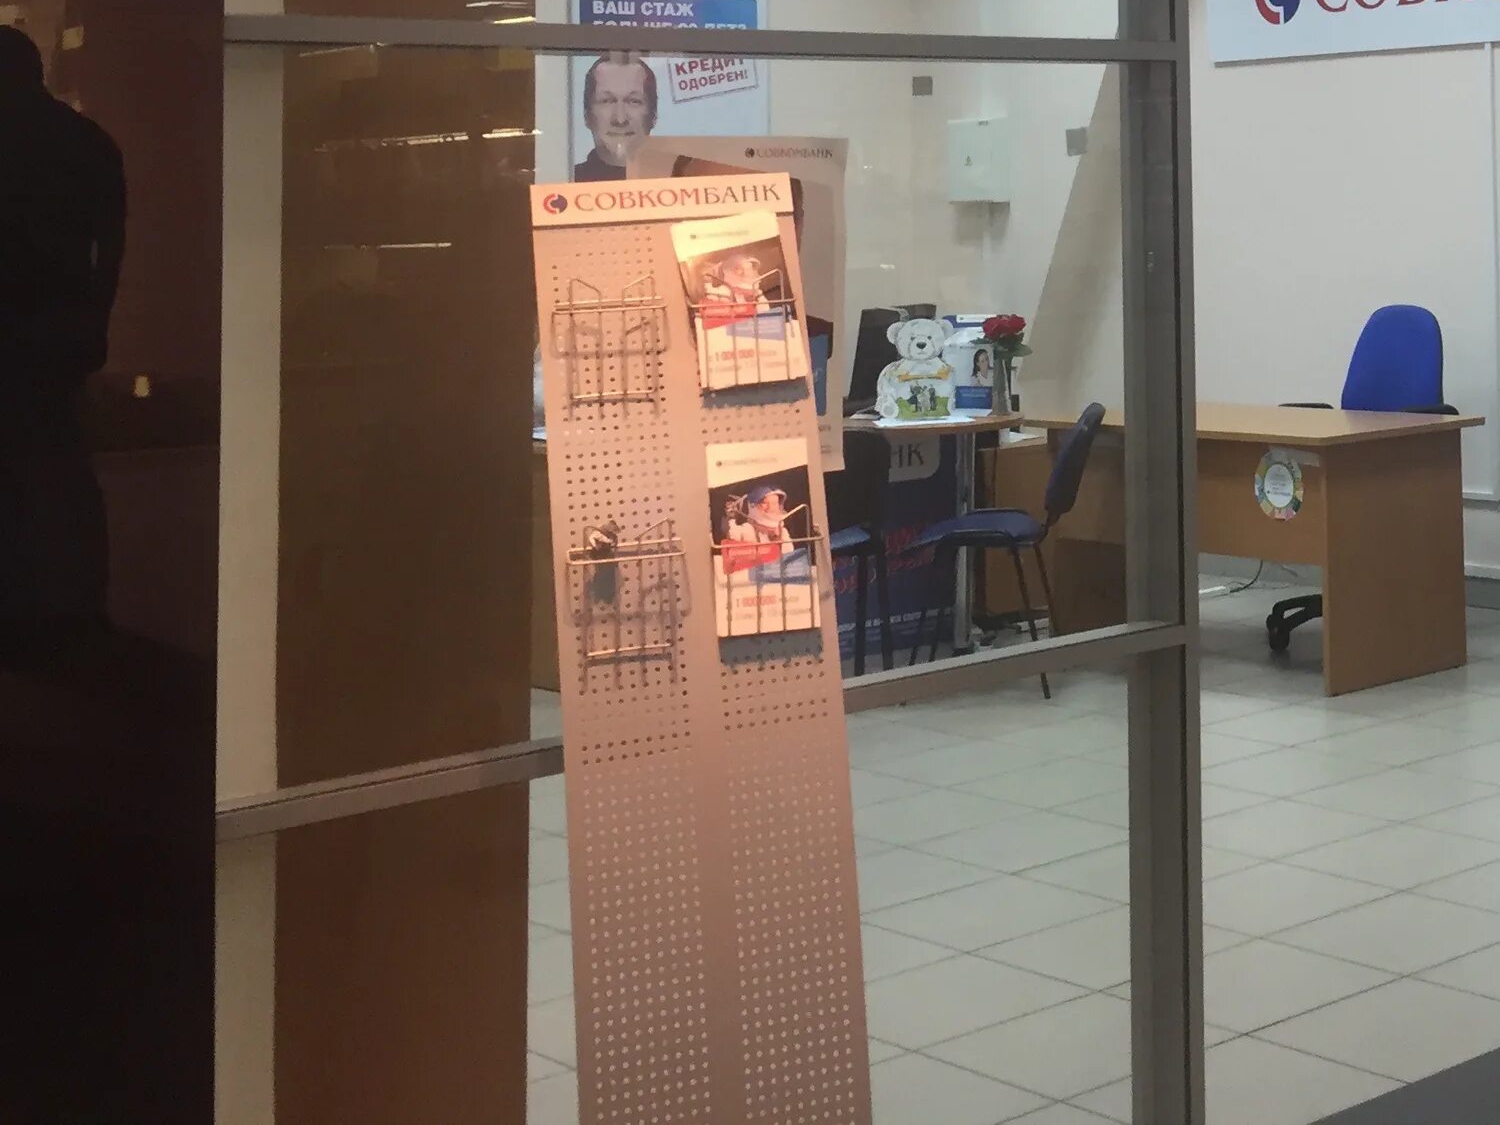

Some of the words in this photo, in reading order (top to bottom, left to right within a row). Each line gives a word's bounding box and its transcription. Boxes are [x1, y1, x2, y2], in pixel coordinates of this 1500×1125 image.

[592, 0, 636, 16] ВАШ
[640, 1, 694, 17] СТАЖ
[678, 69, 748, 91] ОДОБРЕН!
[574, 182, 781, 213] СОВКОМБАНК
